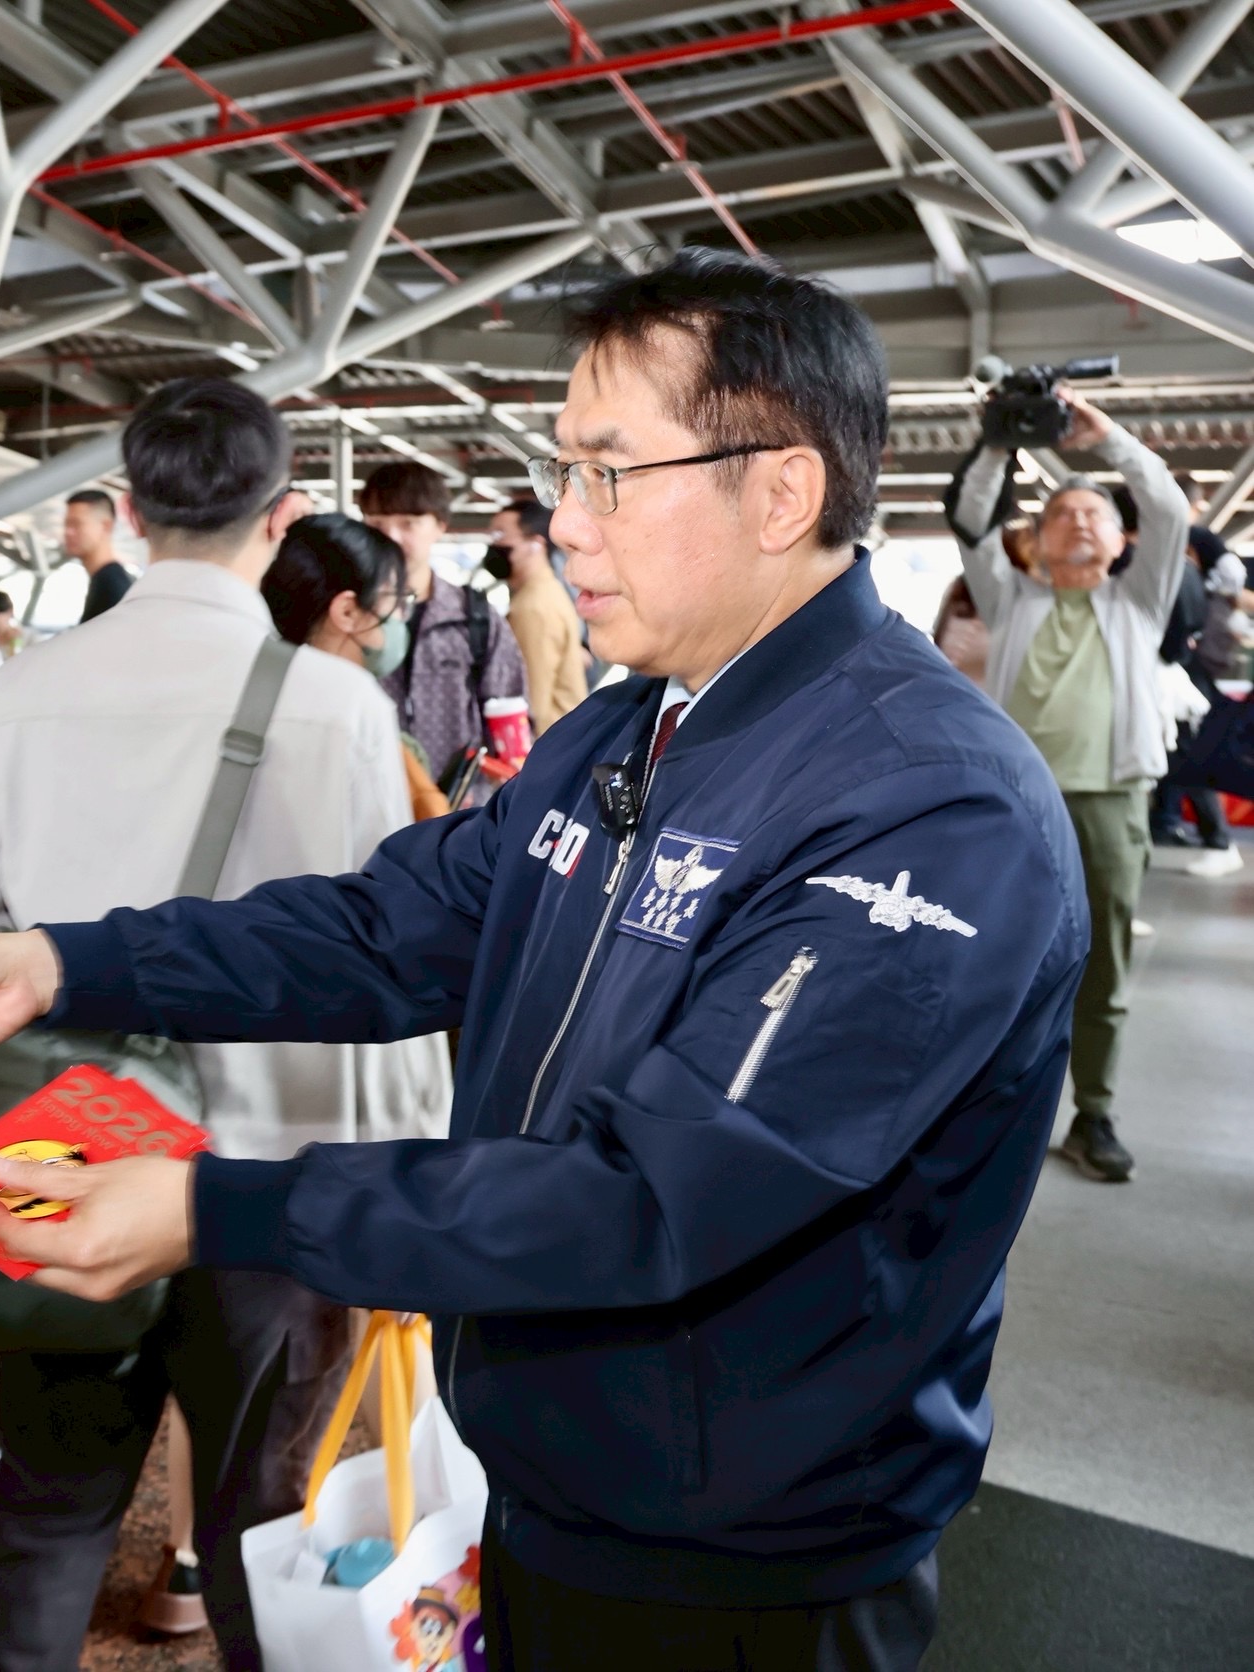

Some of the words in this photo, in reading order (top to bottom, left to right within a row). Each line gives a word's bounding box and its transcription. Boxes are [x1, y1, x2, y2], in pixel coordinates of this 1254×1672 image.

[36, 1096, 82, 1132] Happy
[82, 1125, 117, 1150] New
[49, 1077, 178, 1156] 2026
